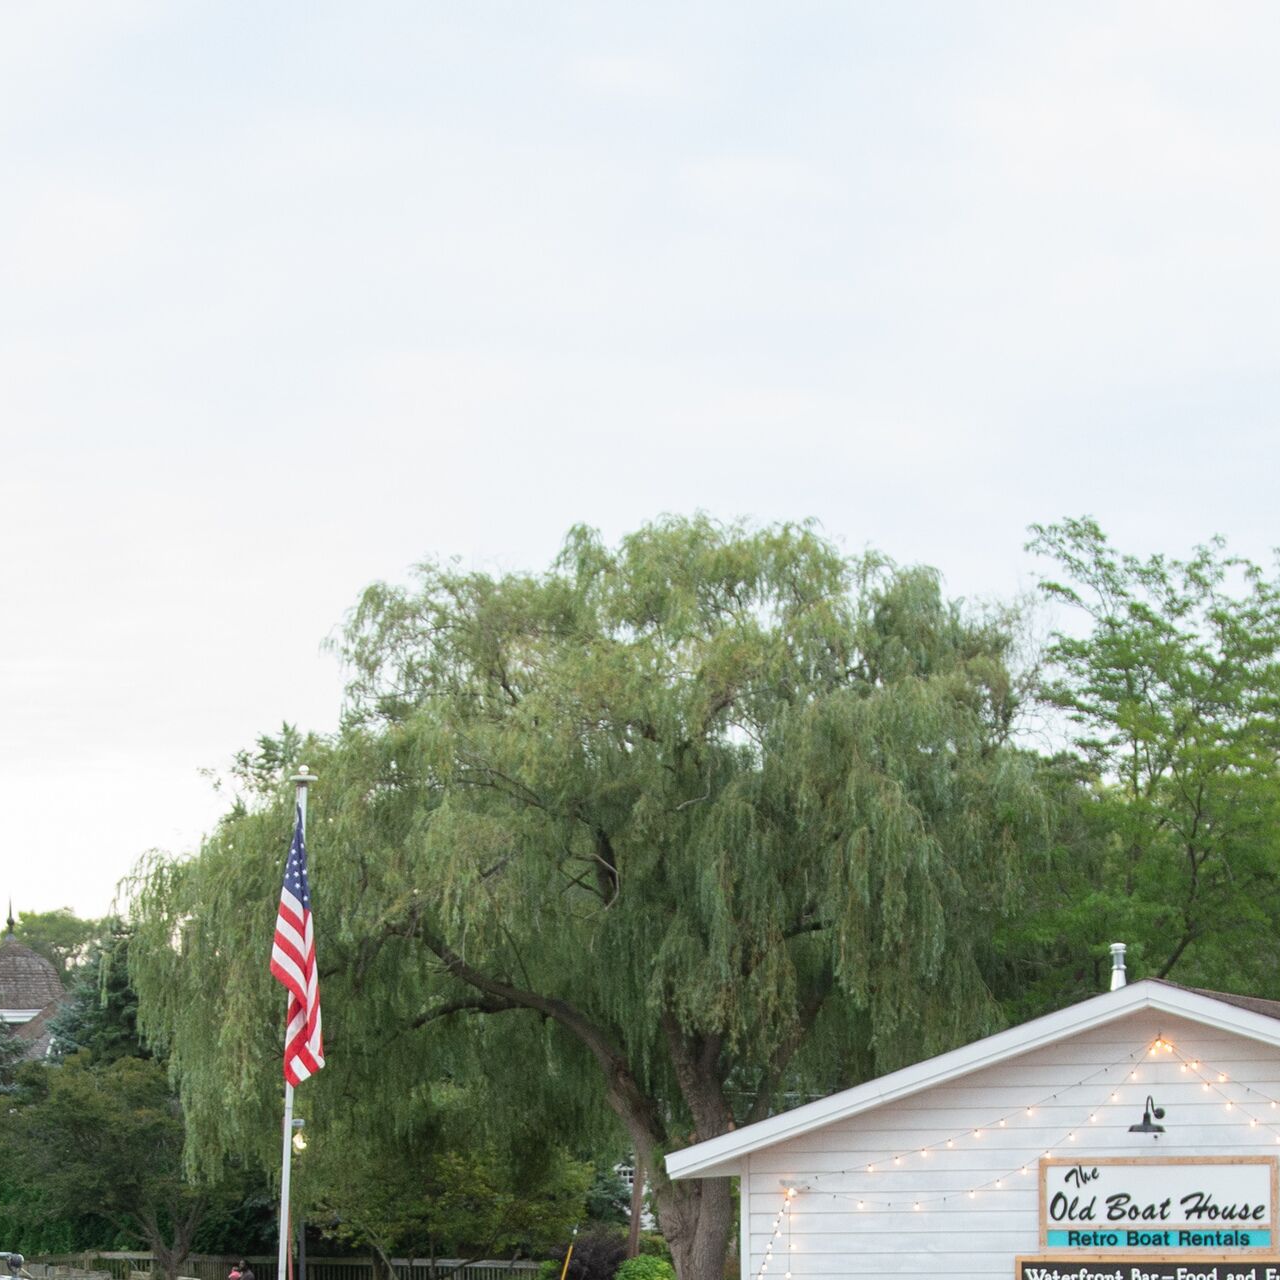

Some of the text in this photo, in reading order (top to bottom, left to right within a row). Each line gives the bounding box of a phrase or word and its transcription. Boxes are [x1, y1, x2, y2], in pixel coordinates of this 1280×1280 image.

[1064, 1165, 1100, 1189] The
[1049, 1191, 1266, 1221] Old Boat House
[1068, 1230, 1250, 1246] Retro Boat Rentals
